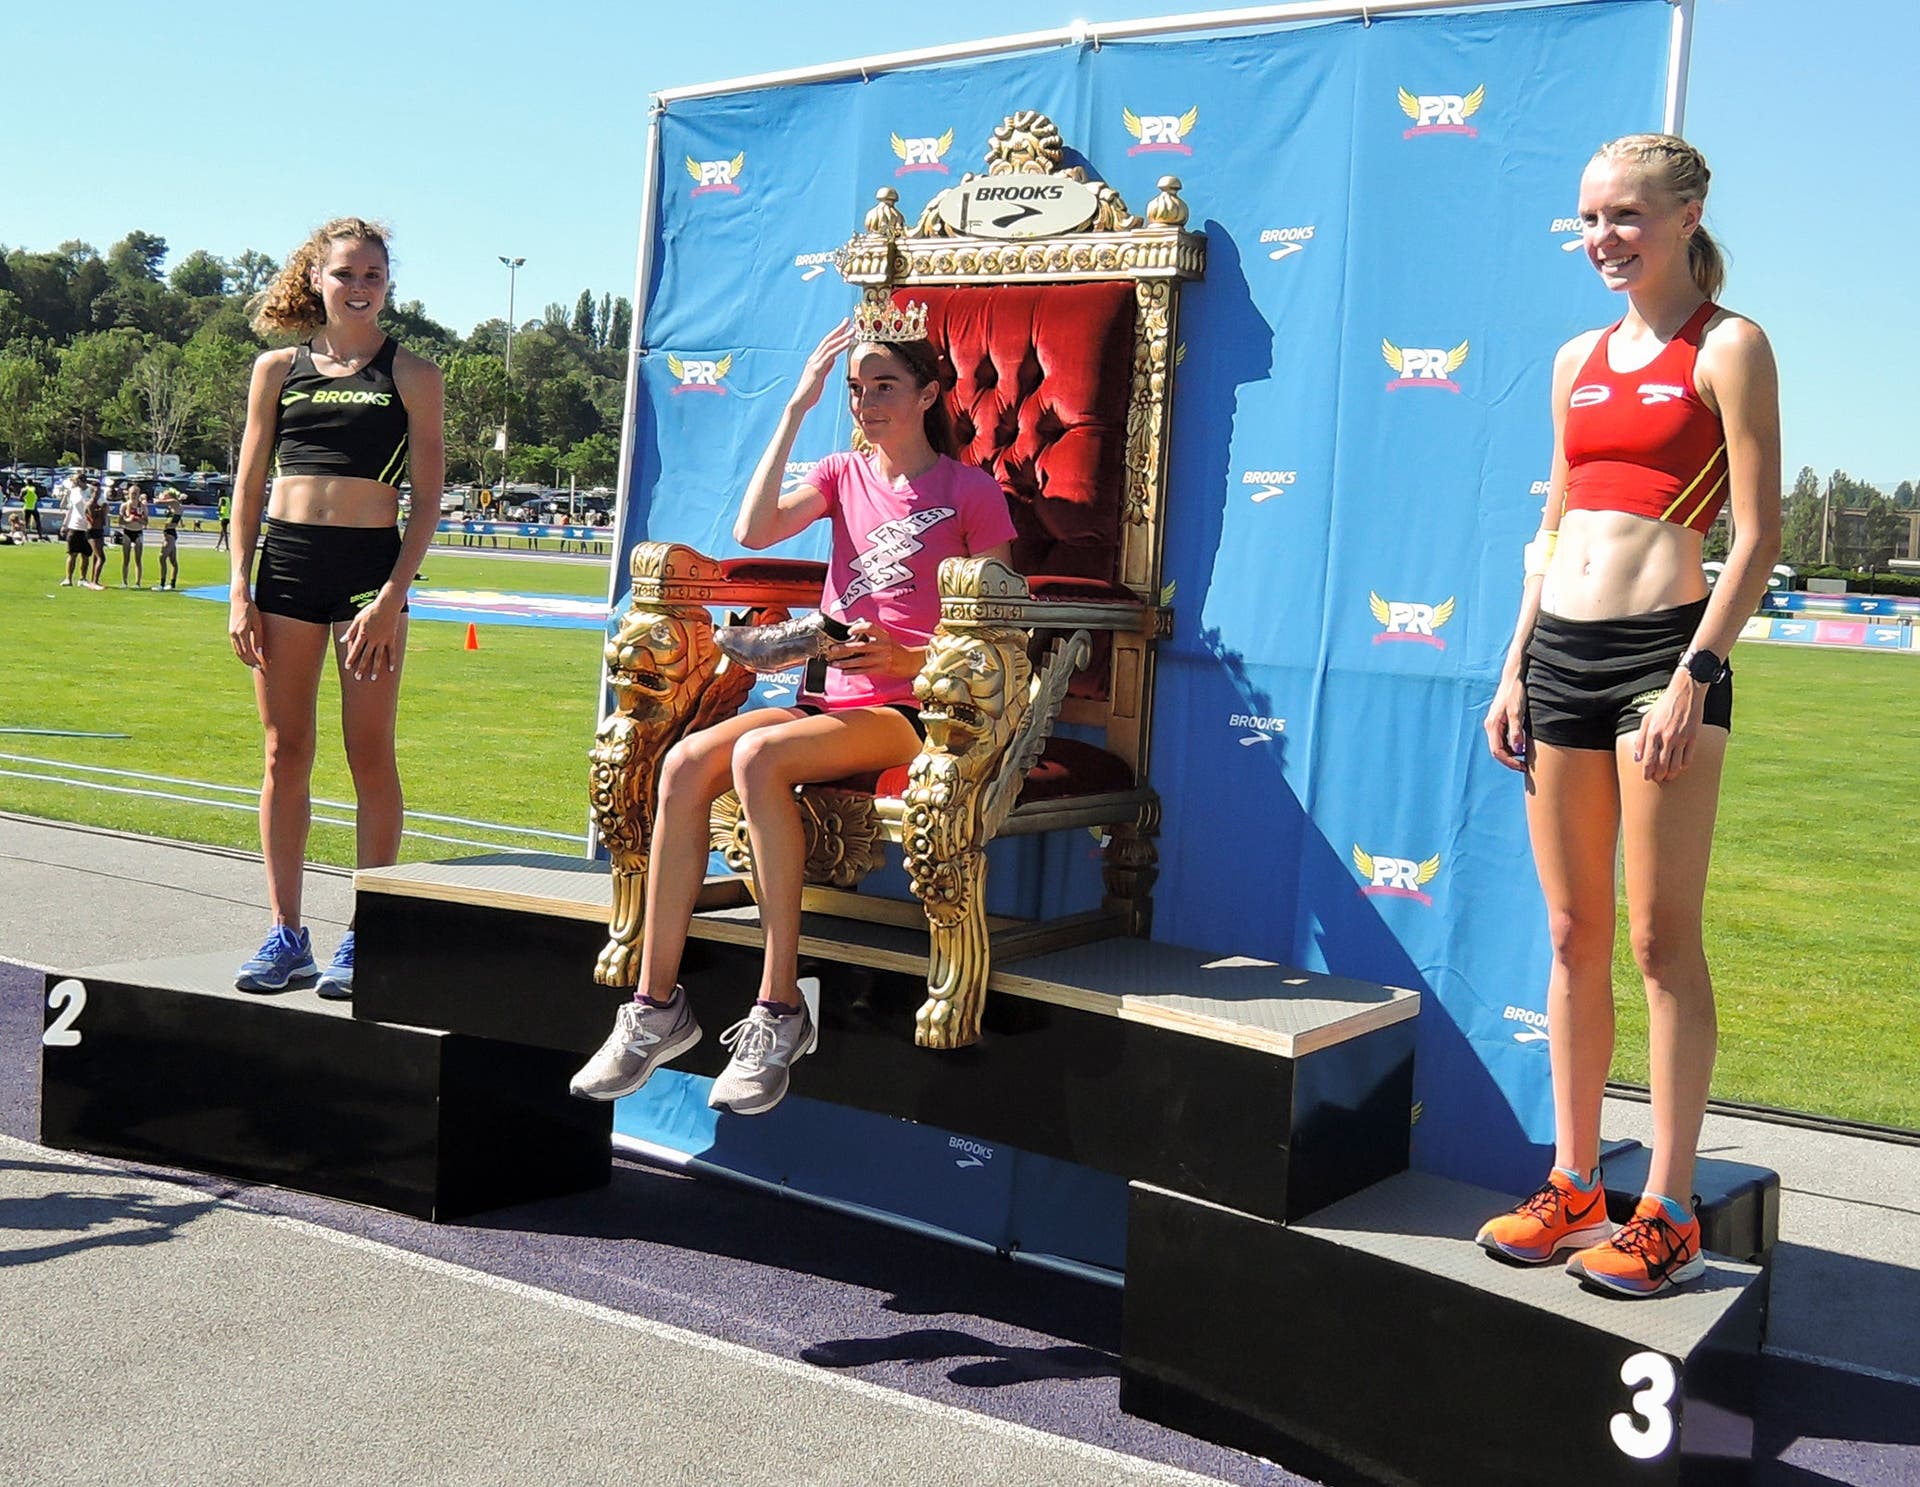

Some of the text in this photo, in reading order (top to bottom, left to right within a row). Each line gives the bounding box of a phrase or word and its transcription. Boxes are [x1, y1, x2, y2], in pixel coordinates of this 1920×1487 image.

[1417, 95, 1464, 126] PR
[1139, 115, 1181, 145] PR
[904, 137, 939, 165] PR
[700, 160, 732, 187] PR
[975, 186, 1064, 201] BROOKS
[1260, 226, 1315, 243] BROOKS
[1551, 218, 1582, 232] BRO
[682, 360, 717, 385] PR
[1399, 348, 1448, 379] PR
[311, 390, 392, 406] BROOKS
[1242, 471, 1297, 484] BROOKS
[875, 509, 946, 543] FASTEST
[862, 540, 911, 569] OF THE
[840, 562, 906, 606] FASTEST
[1386, 601, 1433, 636] PR
[1229, 714, 1286, 731] BROOKS
[1371, 855, 1419, 891] PR
[42, 979, 87, 1046] 2
[1503, 1005, 1548, 1027] BROO
[949, 1136, 993, 1159] BROOKS
[1610, 1352, 1676, 1459] 3
